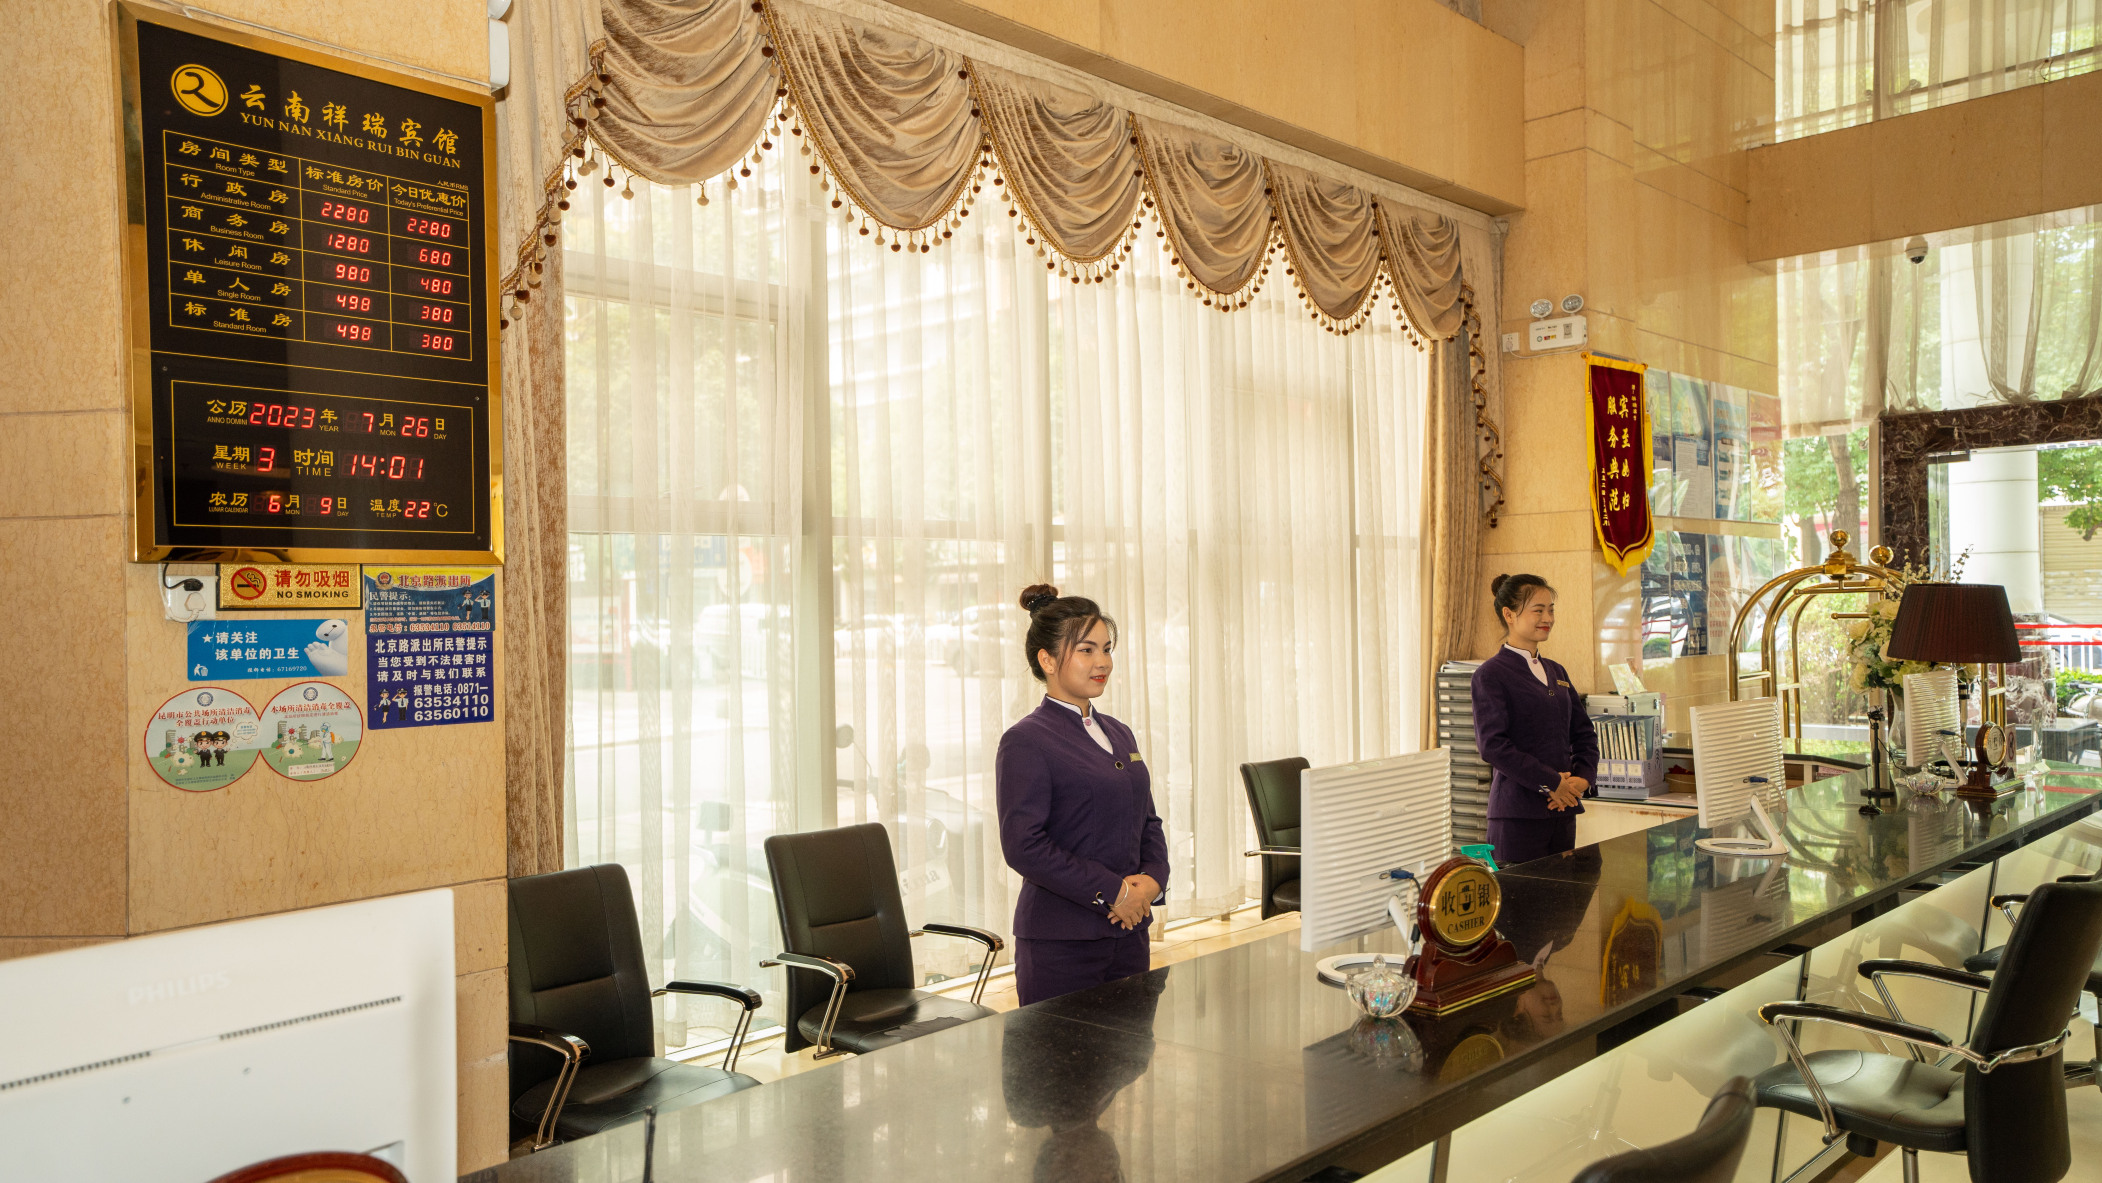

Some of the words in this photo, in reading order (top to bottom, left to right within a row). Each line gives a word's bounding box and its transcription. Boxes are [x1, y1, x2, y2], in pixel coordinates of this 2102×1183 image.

[240, 84, 459, 155] 云南祥瑞宾馆
[240, 112, 275, 129] YUN
[278, 120, 313, 137] NAN
[316, 129, 364, 148] XIANG
[367, 140, 393, 155] RUI
[395, 146, 420, 160] BIN
[423, 152, 461, 169] GUAN
[178, 141, 289, 174] 房间类型
[215, 162, 237, 173] Room
[239, 167, 255, 177] Type
[305, 165, 384, 192] 标准房价
[180, 173, 289, 204] 行政房
[322, 184, 351, 196] Standard
[352, 188, 368, 199] Price
[391, 183, 467, 208] 今日优惠价
[200, 192, 250, 208] Administrative
[250, 200, 272, 211] Room
[393, 197, 416, 209] Today's
[416, 201, 449, 214] Preferential
[449, 207, 464, 217] Price
[181, 205, 290, 235] 商务房
[321, 202, 369, 224] 2280
[210, 225, 243, 237] Business
[243, 230, 265, 240] Room
[407, 218, 451, 238] 2280
[182, 238, 291, 266] 休闲房
[327, 233, 370, 253] 1280
[214, 257, 240, 268] Leisure
[241, 261, 262, 271] Room
[419, 248, 452, 266] 680
[336, 263, 371, 283] 980
[183, 269, 292, 296] 单人房
[420, 277, 452, 295] 480
[217, 289, 239, 300] Single
[240, 292, 262, 302] Room
[336, 294, 371, 312] 498
[184, 301, 293, 327] 标准房
[421, 305, 453, 323] 380
[213, 320, 245, 331] Standard
[245, 323, 267, 333] Room
[336, 323, 372, 341] 498
[421, 334, 453, 351] 380
[207, 399, 248, 416] 公历
[250, 403, 316, 429] 2023
[320, 408, 338, 424] 年
[362, 412, 374, 433] 7
[379, 413, 394, 428] 月
[401, 416, 429, 438] 26
[435, 418, 445, 431] 日
[207, 416, 226, 424] ANNO
[226, 417, 248, 426] DOMINI
[380, 429, 396, 437] MON
[212, 445, 250, 463] 星期
[257, 447, 276, 472] 3
[294, 448, 334, 467] 时间
[350, 454, 424, 479] 14:01
[216, 461, 247, 470] WEEK
[296, 466, 332, 477] TIME
[209, 491, 249, 507] 农历
[268, 495, 281, 513] 6
[285, 494, 300, 509] 月
[320, 497, 333, 514] 9
[337, 497, 347, 509] 日
[370, 498, 402, 513] 温度
[404, 501, 431, 518] 22
[274, 569, 350, 589] 请勿吸烟
[398, 574, 472, 588] 北京路派出所
[277, 591, 293, 599] NO
[296, 590, 349, 599] SMOKING
[216, 631, 258, 644] 请关注
[375, 636, 487, 654] 北京路派出所民警提示
[215, 647, 300, 661] 该单位的卫生
[378, 653, 487, 668] 当您受到不法侵害时
[377, 666, 487, 682] 请及时与我们联系
[414, 694, 489, 709] 63534110
[414, 705, 489, 722] 63560110
[1441, 891, 1456, 916] 收
[1478, 883, 1490, 908] 银
[1447, 916, 1485, 934] CASHIER
[127, 970, 232, 1004] PHILIPS
